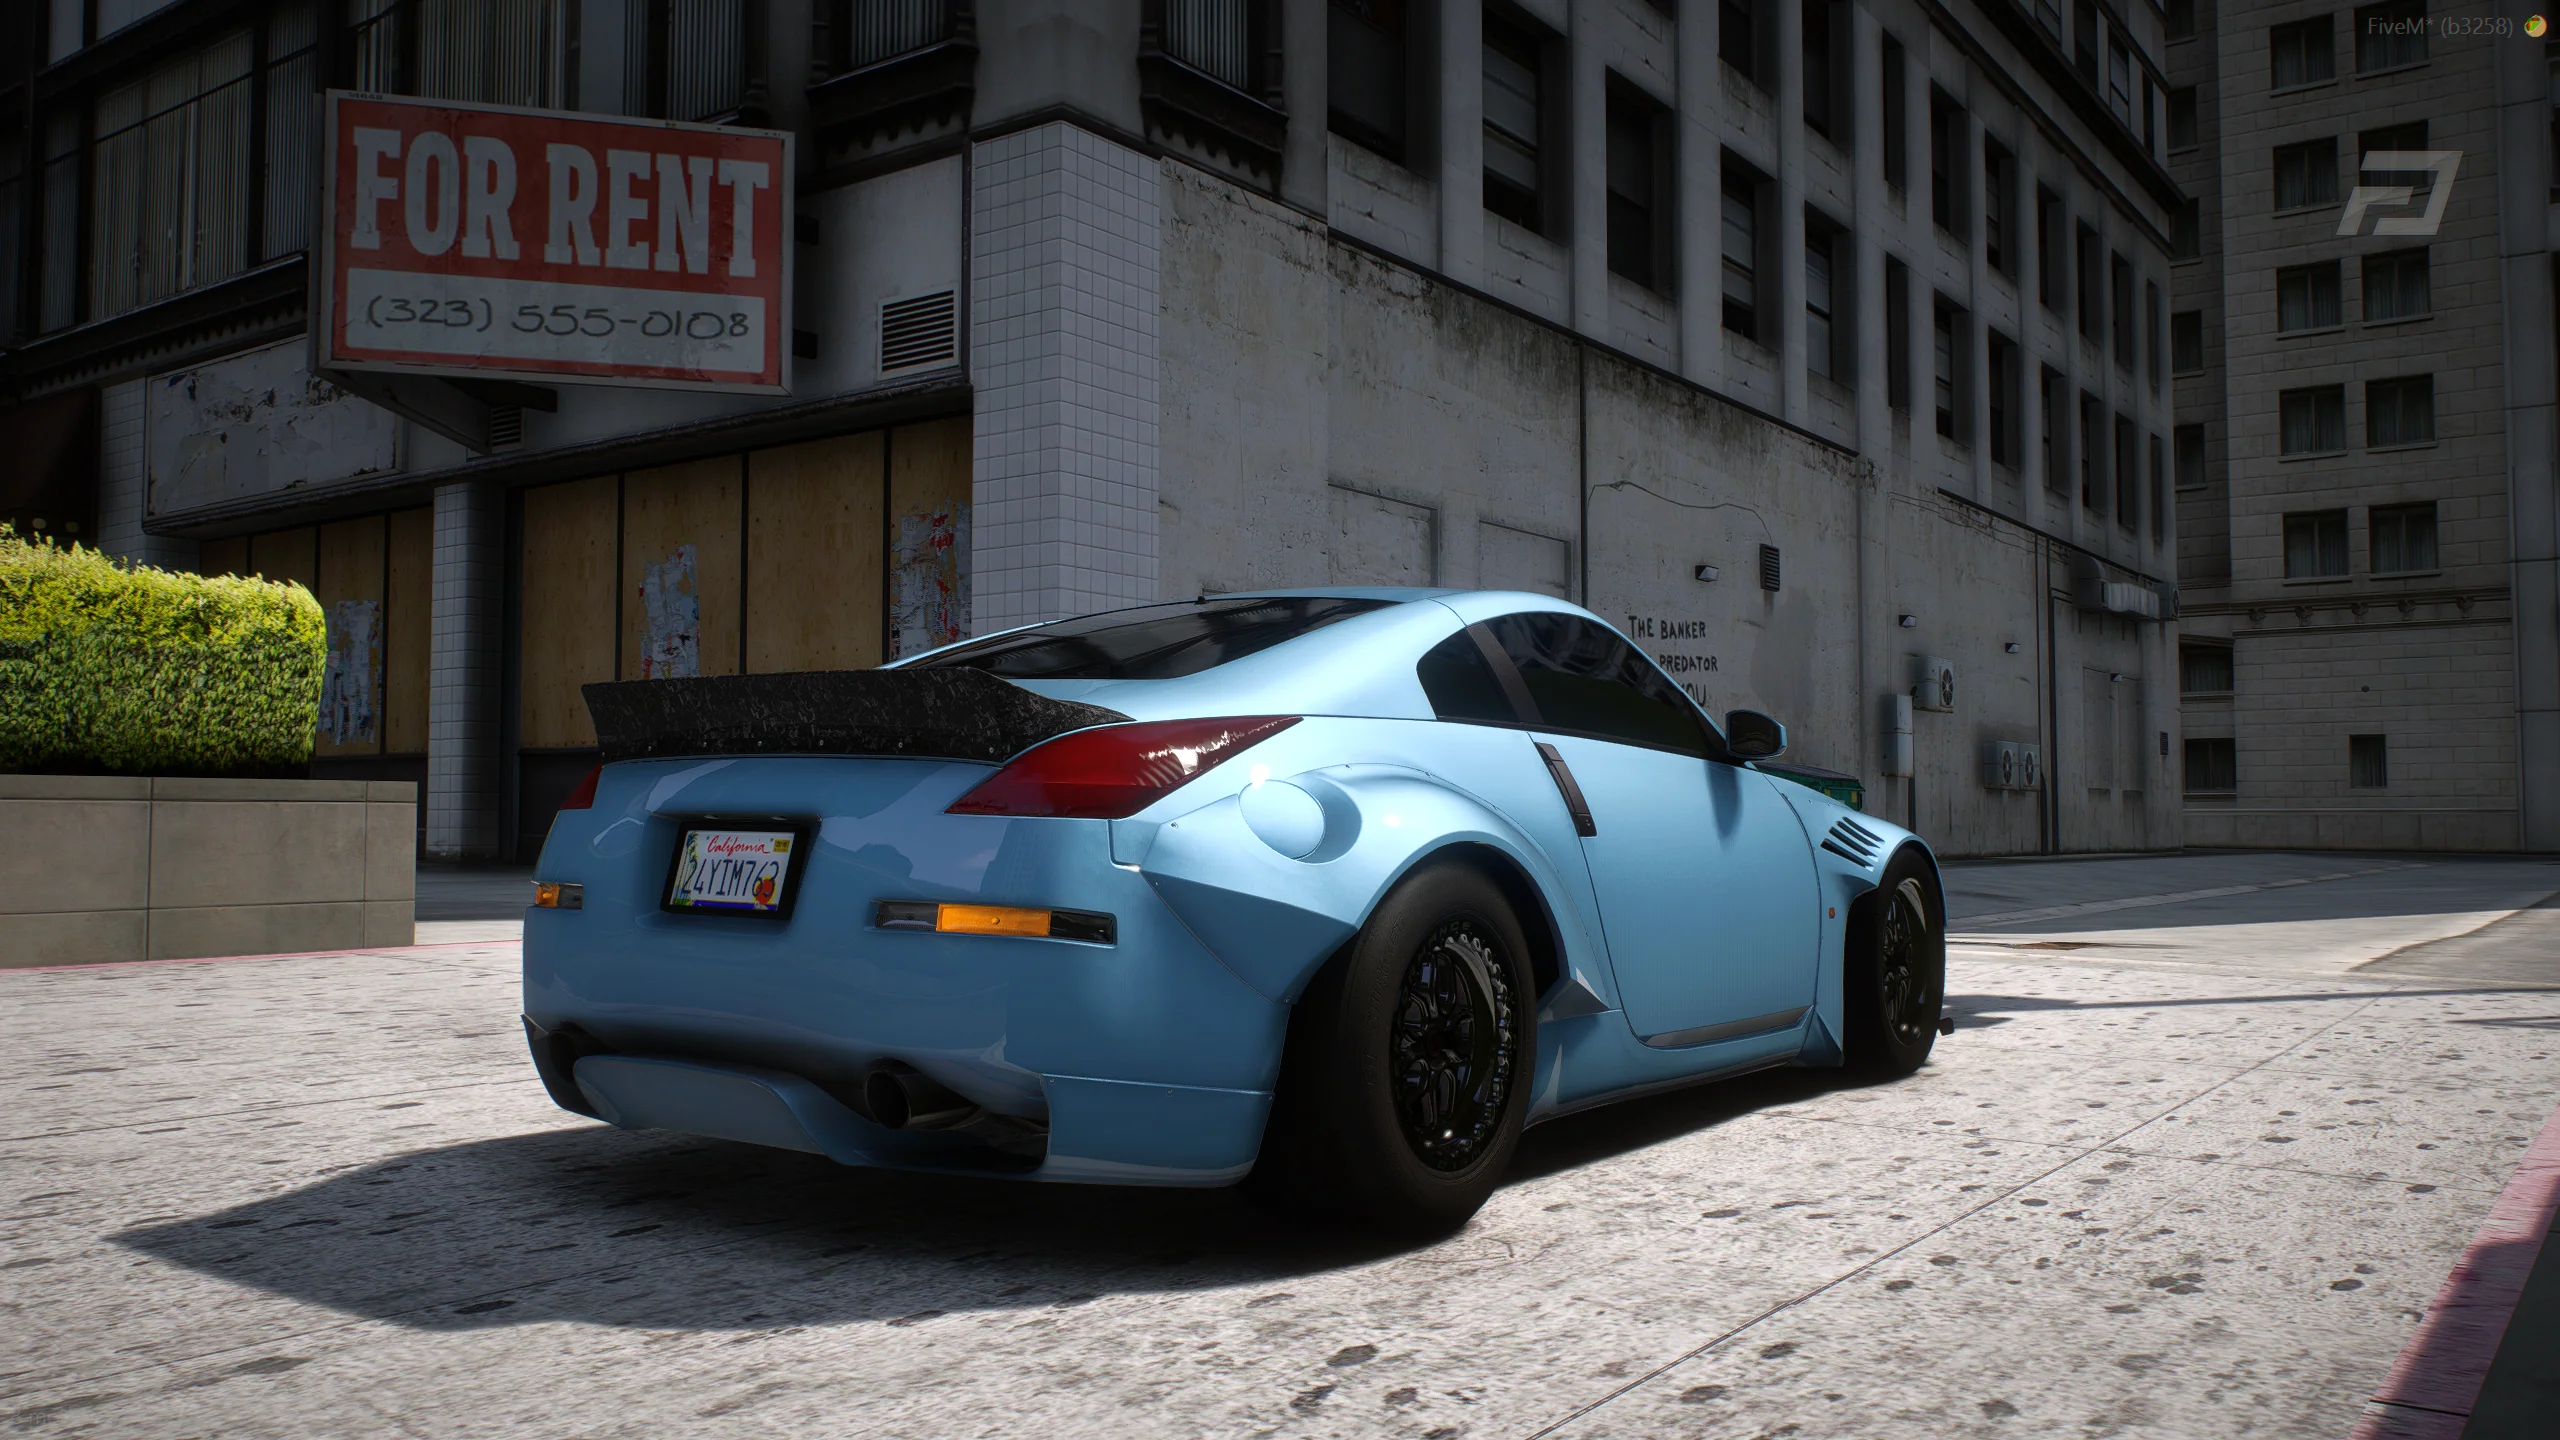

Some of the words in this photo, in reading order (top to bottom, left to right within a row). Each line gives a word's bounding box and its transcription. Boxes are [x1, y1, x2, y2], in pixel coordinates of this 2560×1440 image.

[350, 126, 520, 261] FOR
[544, 142, 770, 278] RENT
[367, 295, 493, 333] (323)
[511, 304, 750, 340] 555-0108
[1628, 615, 1655, 640] THE
[1660, 619, 1707, 640] BANKER
[1659, 654, 1719, 673] PREDATOR
[1681, 682, 1707, 707] OU
[707, 835, 770, 857] California
[681, 857, 780, 898] 24YIM763
